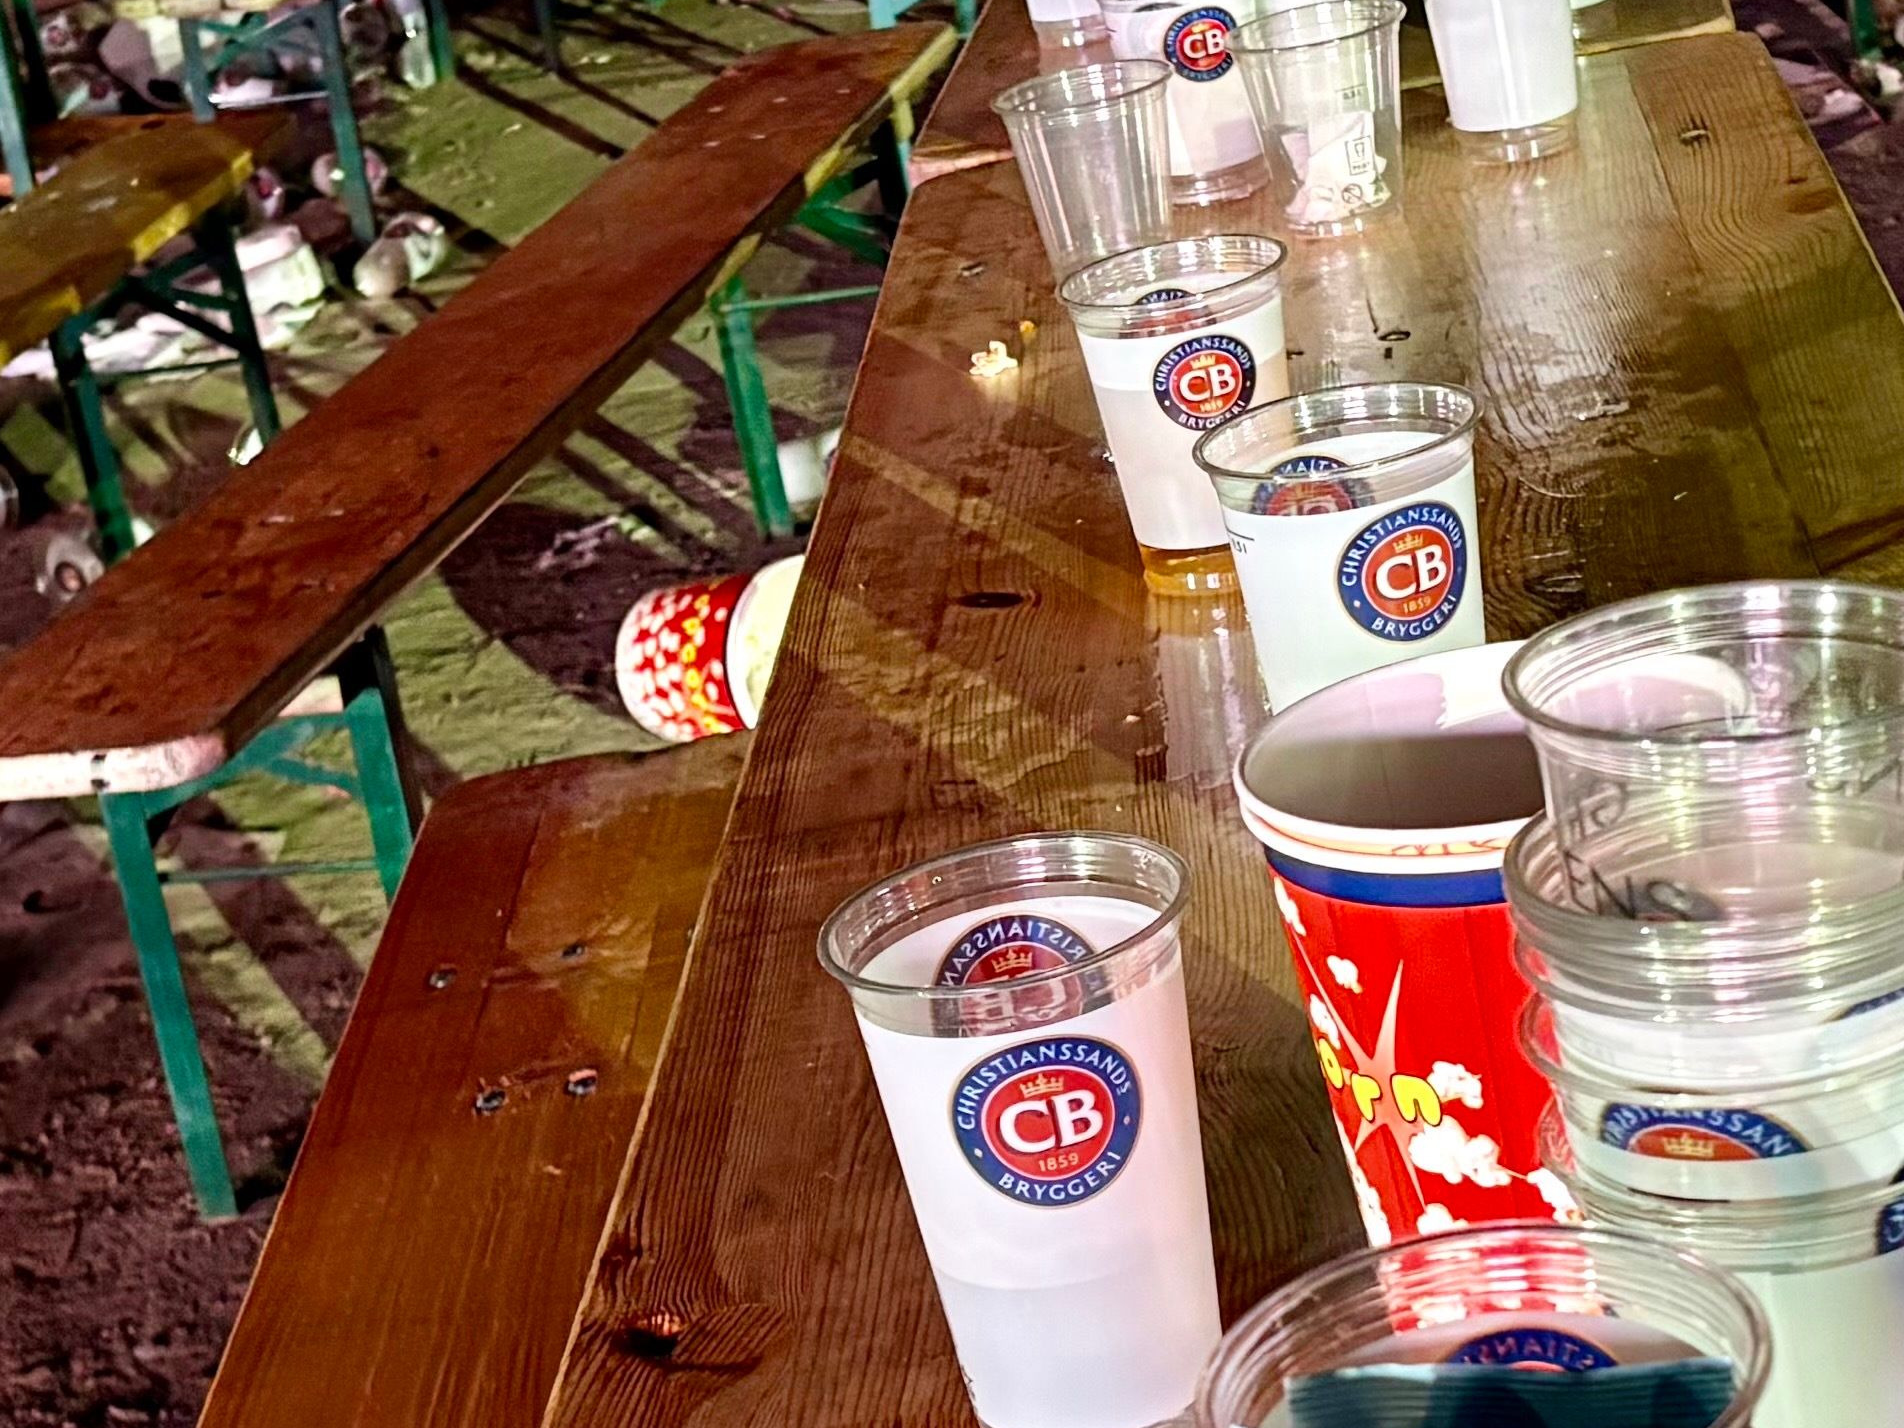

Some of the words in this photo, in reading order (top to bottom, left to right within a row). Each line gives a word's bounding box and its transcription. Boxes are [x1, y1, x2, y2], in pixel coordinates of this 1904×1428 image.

[1182, 28, 1226, 60] CB
[1179, 363, 1237, 402] CB
[1341, 507, 1463, 588] CHRISTIANSSANDS
[1376, 543, 1448, 600] CB
[1371, 593, 1458, 638] BRYGGERI
[1402, 595, 1432, 615] 1859
[956, 1043, 1134, 1130] CHRISTIANSSANDS
[999, 1088, 1104, 1154] CB
[998, 1151, 1122, 1200] BRYGGERI
[1038, 1153, 1080, 1171] 1859
